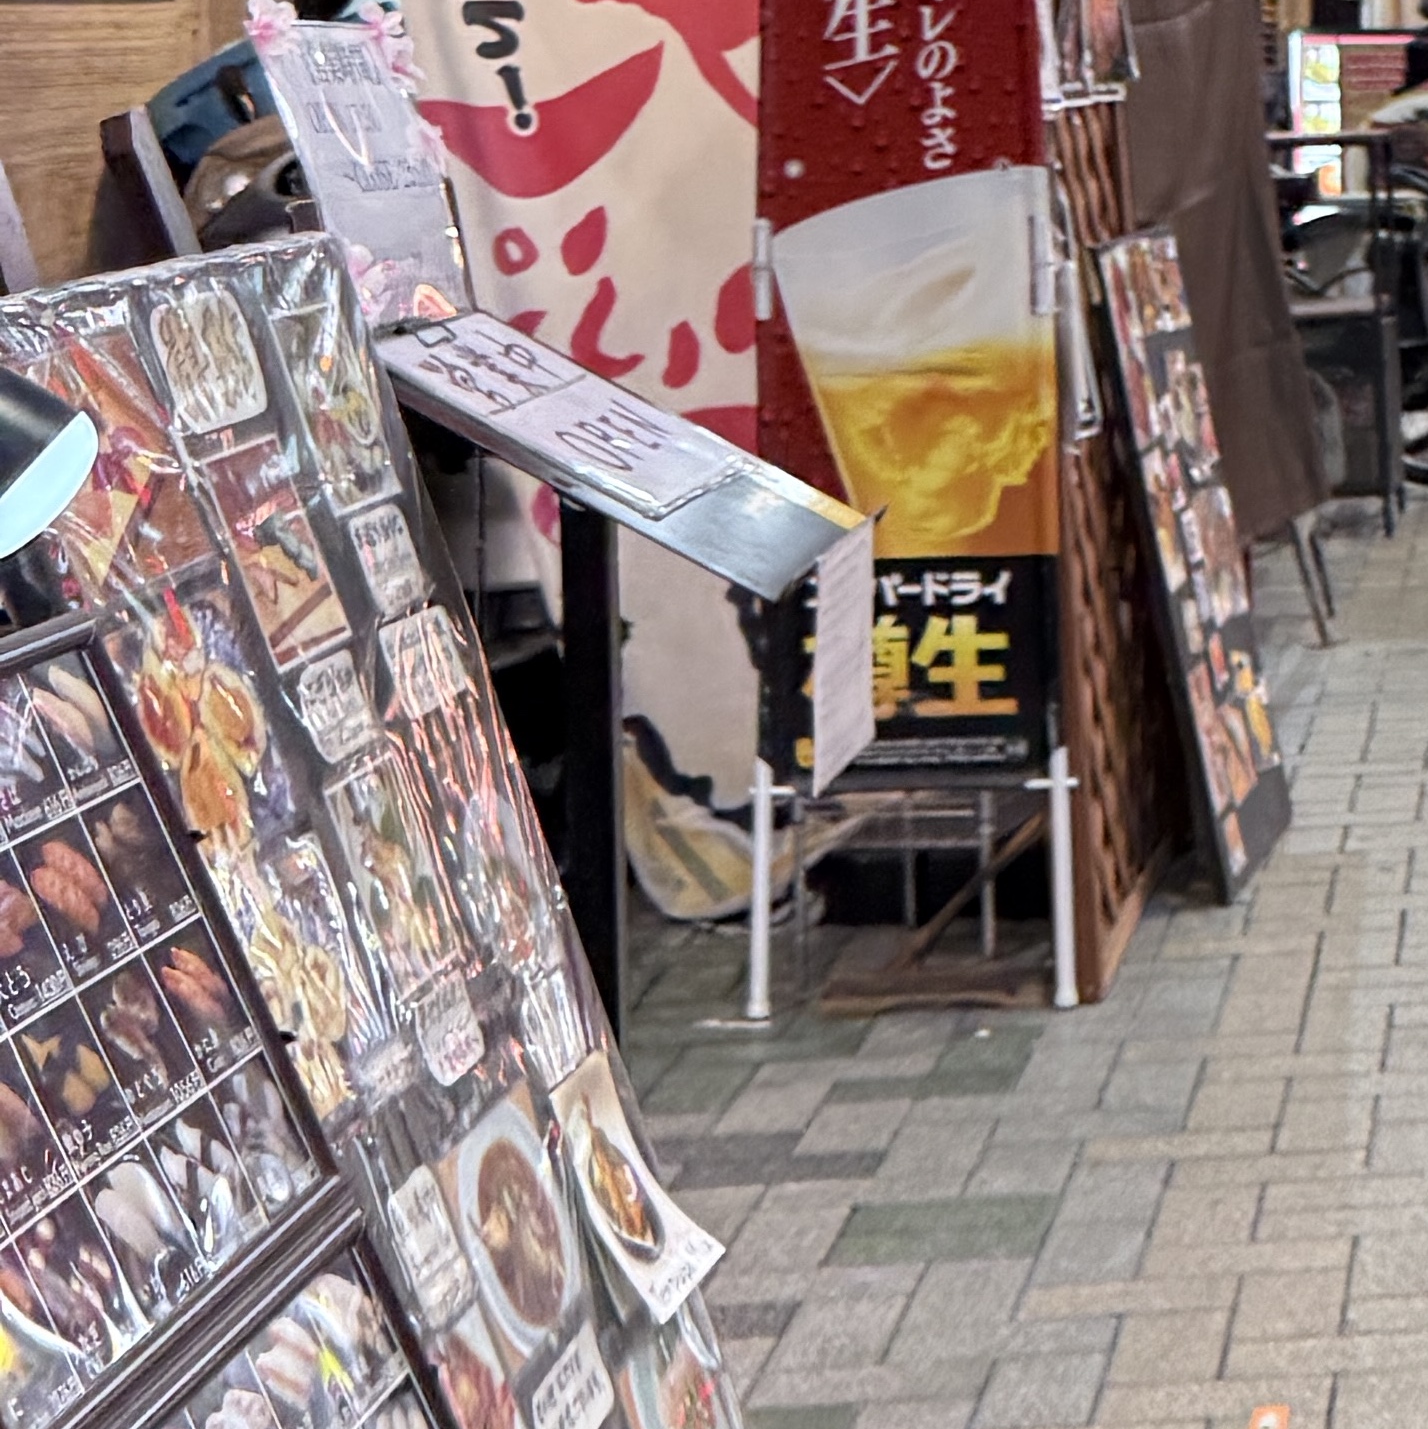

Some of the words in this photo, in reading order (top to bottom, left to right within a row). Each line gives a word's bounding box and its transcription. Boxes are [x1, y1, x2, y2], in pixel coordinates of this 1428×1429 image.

[555, 397, 673, 472] OPEN
[806, 570, 1012, 606] パードライ
